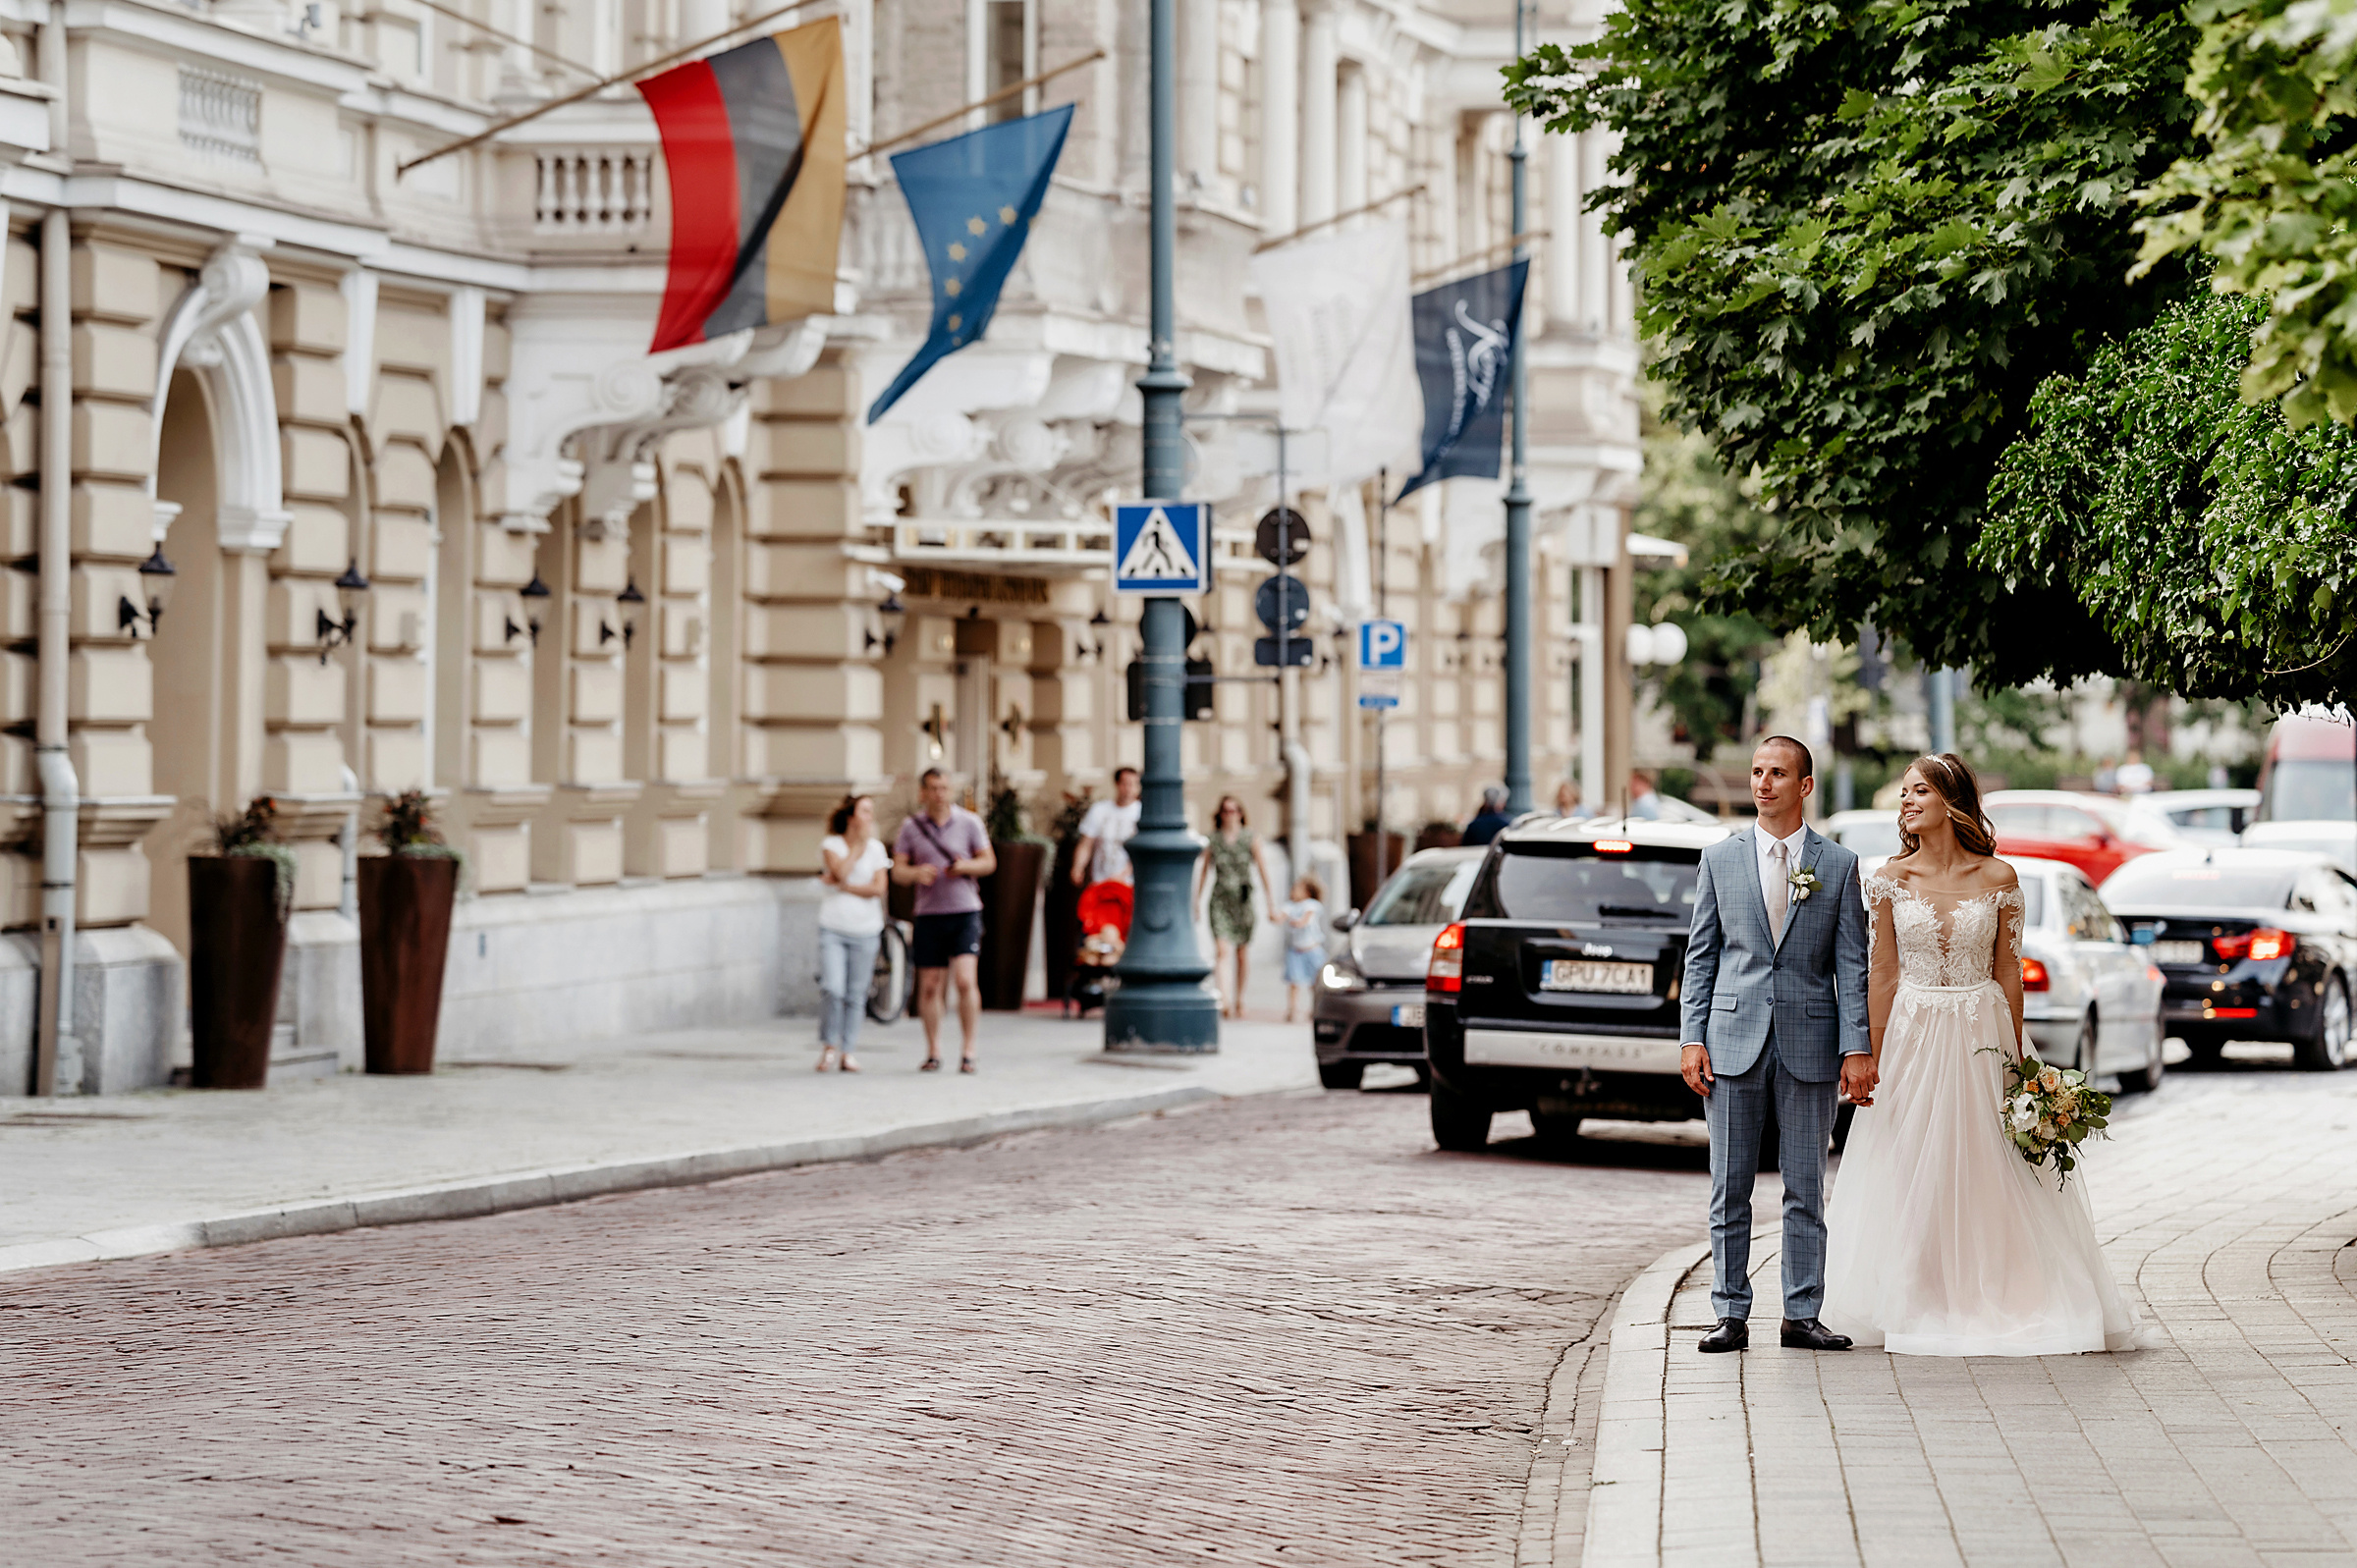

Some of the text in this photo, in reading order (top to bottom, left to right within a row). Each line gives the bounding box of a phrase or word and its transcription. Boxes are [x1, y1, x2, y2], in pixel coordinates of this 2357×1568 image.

[1368, 624, 1400, 666] P
[1581, 943, 1614, 957] Jeep
[1555, 964, 1596, 984] GPU
[1538, 1042, 1642, 1058] COMPASS
